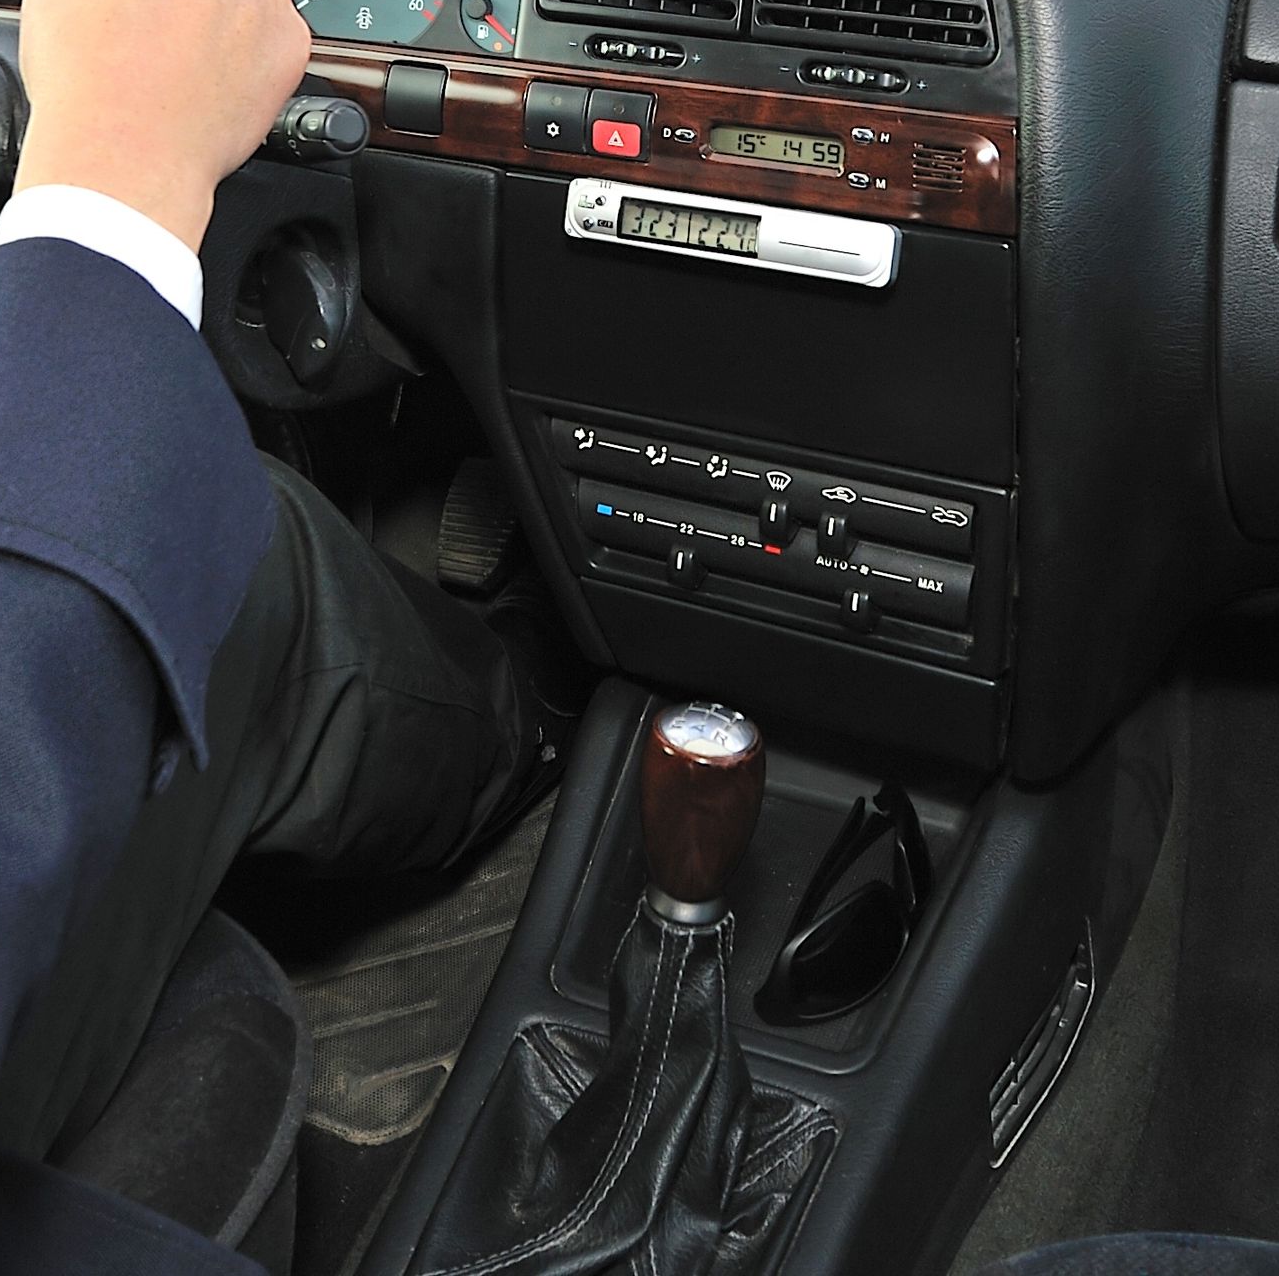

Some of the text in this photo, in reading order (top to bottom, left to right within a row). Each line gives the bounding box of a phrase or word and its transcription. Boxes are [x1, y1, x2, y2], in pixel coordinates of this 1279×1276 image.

[663, 127, 672, 139] D
[880, 133, 890, 144] H
[783, 139, 803, 158] 14
[812, 142, 841, 165] 59
[875, 178, 886, 190] M
[679, 523, 695, 536] 22
[730, 534, 746, 547] 26
[816, 555, 849, 572] AUTO
[917, 578, 945, 594] MAX
